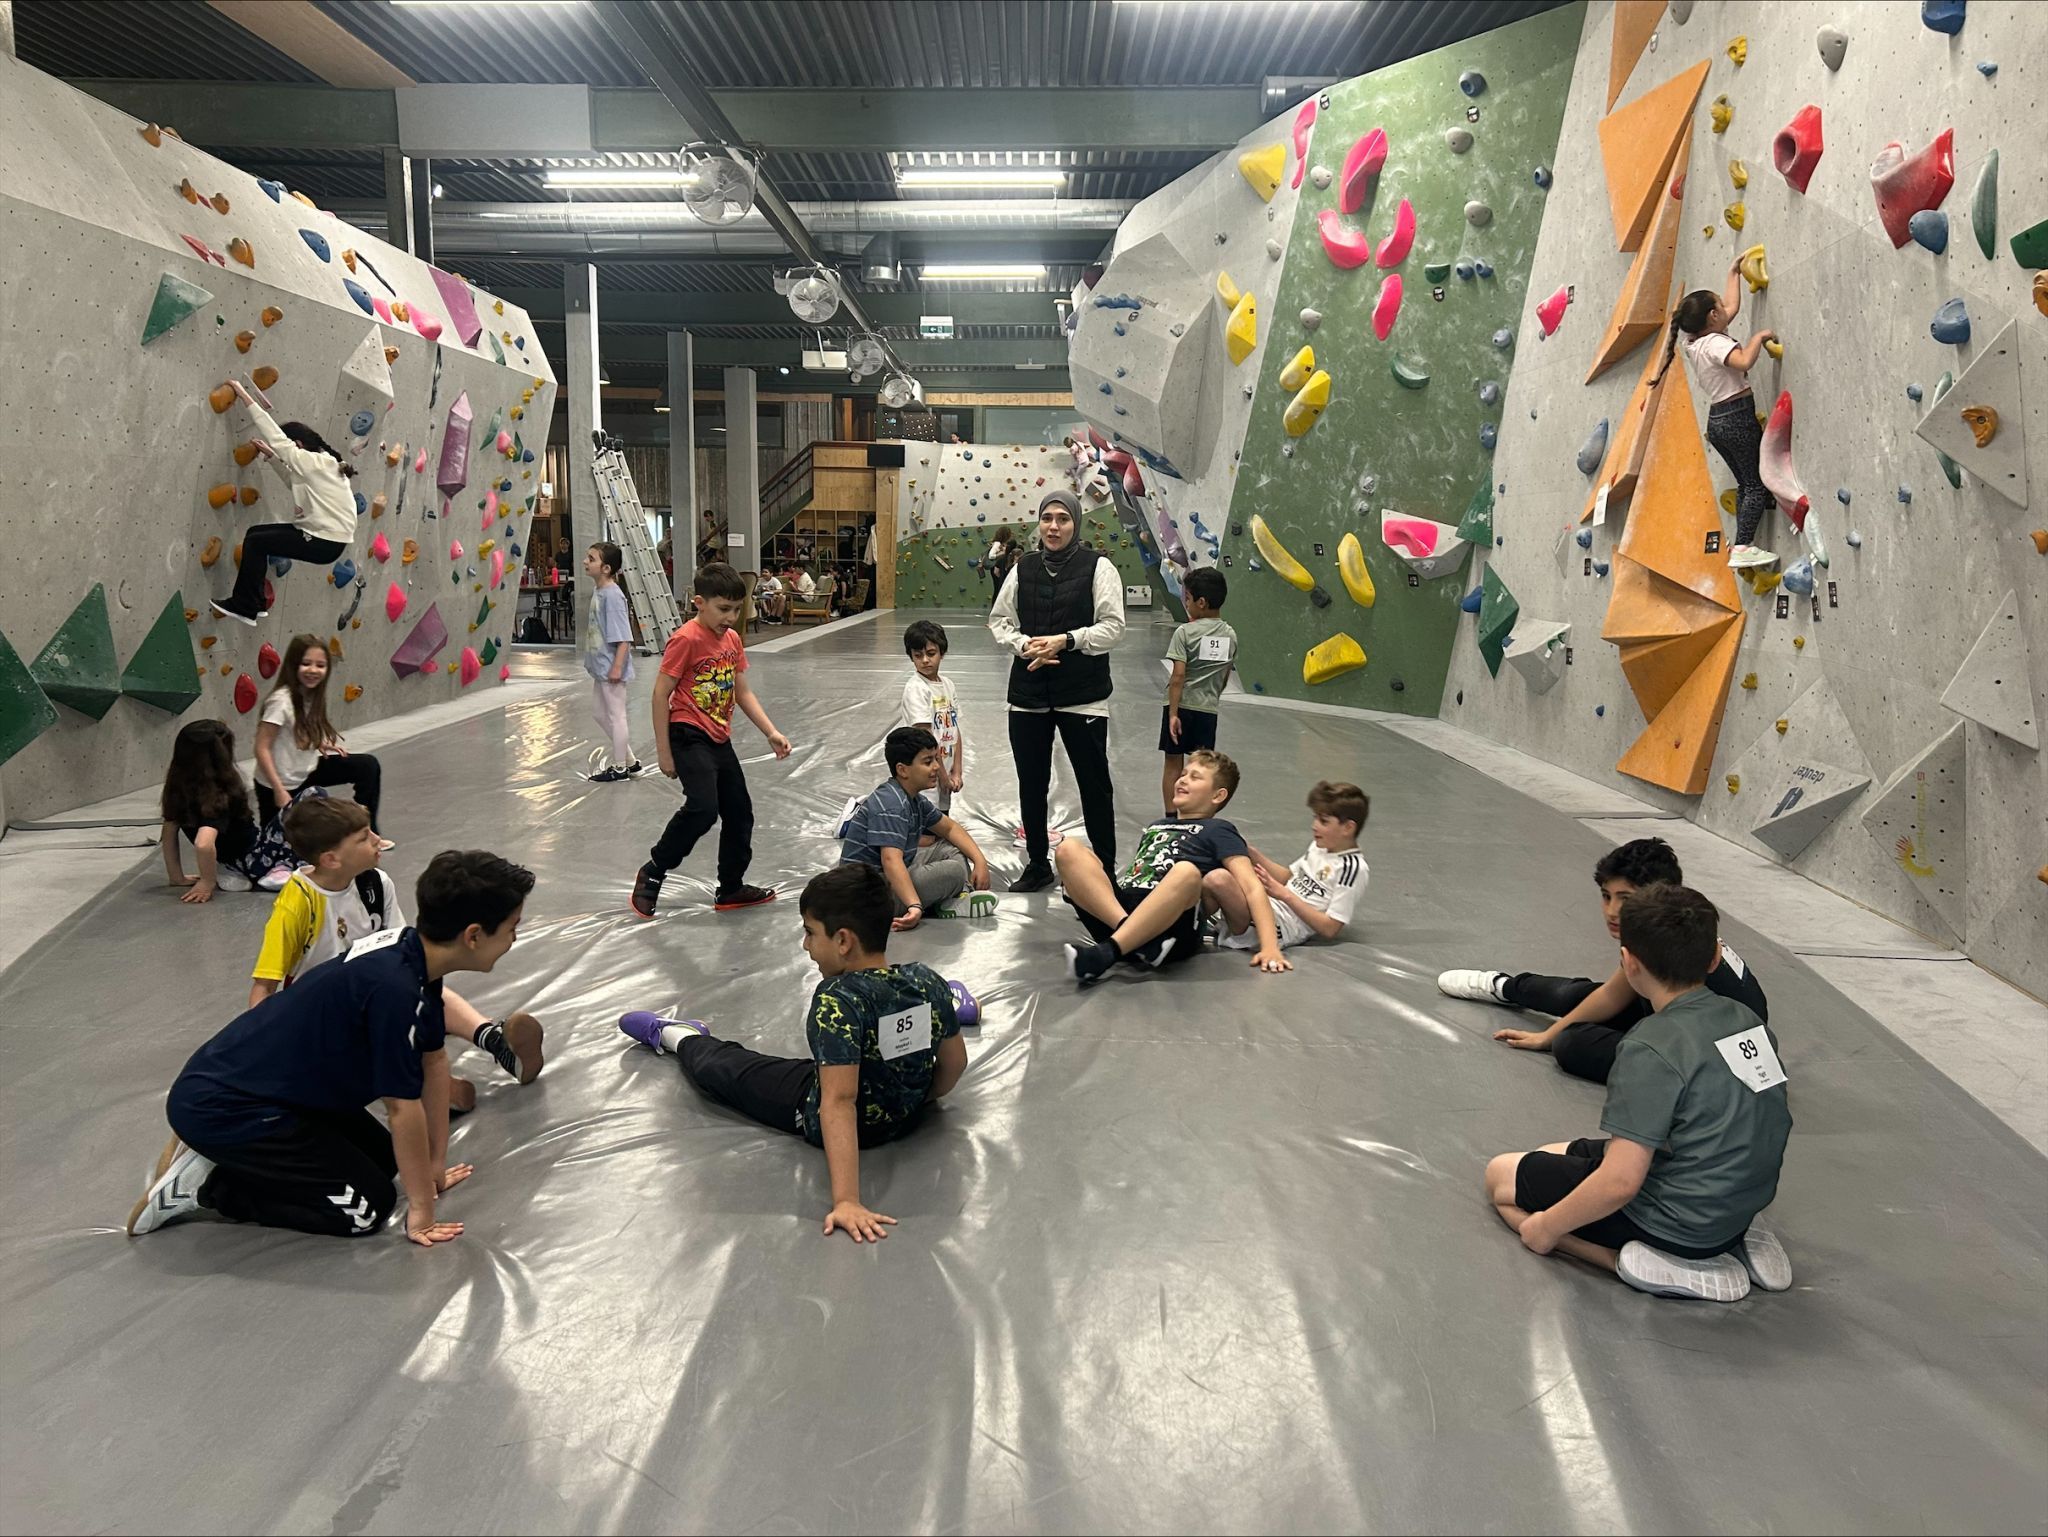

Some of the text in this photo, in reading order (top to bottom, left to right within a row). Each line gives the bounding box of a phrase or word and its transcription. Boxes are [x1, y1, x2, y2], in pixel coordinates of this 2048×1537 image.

[1209, 640, 1220, 649] 91
[1792, 765, 1826, 785] deuter
[896, 1014, 914, 1034] 85
[1738, 1039, 1759, 1060] 89
